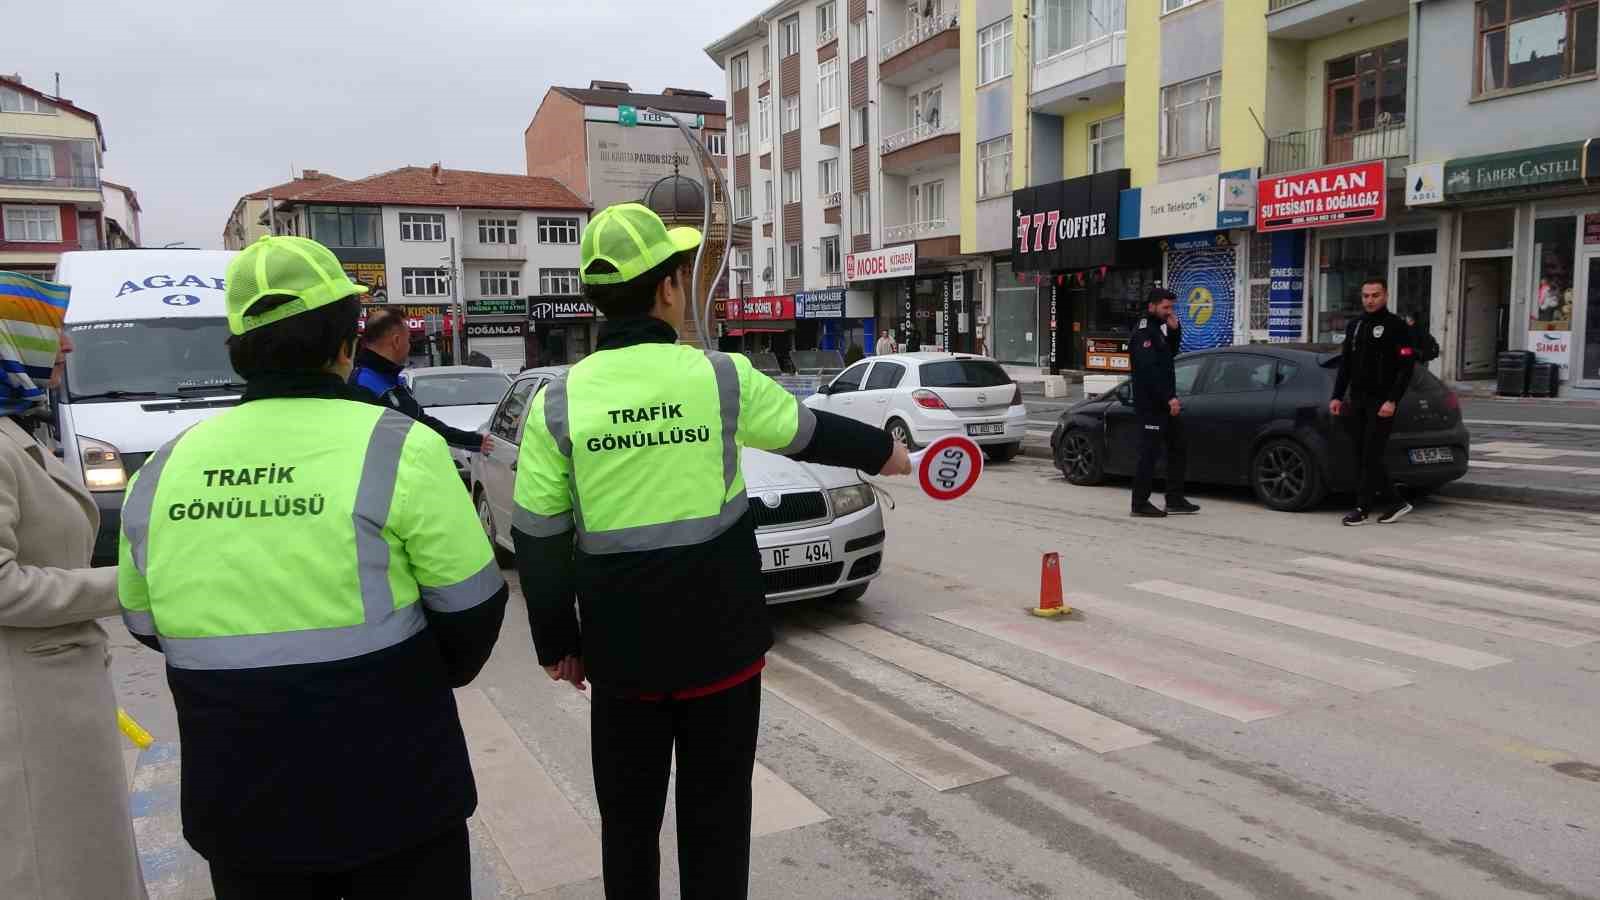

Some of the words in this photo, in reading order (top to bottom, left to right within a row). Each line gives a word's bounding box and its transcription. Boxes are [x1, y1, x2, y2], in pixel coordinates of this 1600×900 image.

[634, 152, 659, 164] PATRON
[1275, 171, 1367, 198] ÜNALAN
[1150, 205, 1164, 215] Türk
[1167, 201, 1198, 213] Telekom
[1262, 204, 1273, 218] SU
[1325, 191, 1380, 211] DOĞALGAZ
[1019, 209, 1060, 253] 777
[1060, 212, 1106, 240] COFFEE
[857, 256, 888, 276] MODEL
[1271, 281, 1290, 290] GSM
[555, 303, 595, 313] HAKAN
[608, 402, 683, 424] TRAFİK
[586, 425, 710, 452] GÖNÜLLÜSÜ
[203, 463, 296, 487] TRAFİK
[936, 448, 964, 489] STOP
[168, 493, 325, 521] GÖNÜLLÜSÜ
[773, 548, 790, 567] DF
[805, 544, 829, 562] 494
